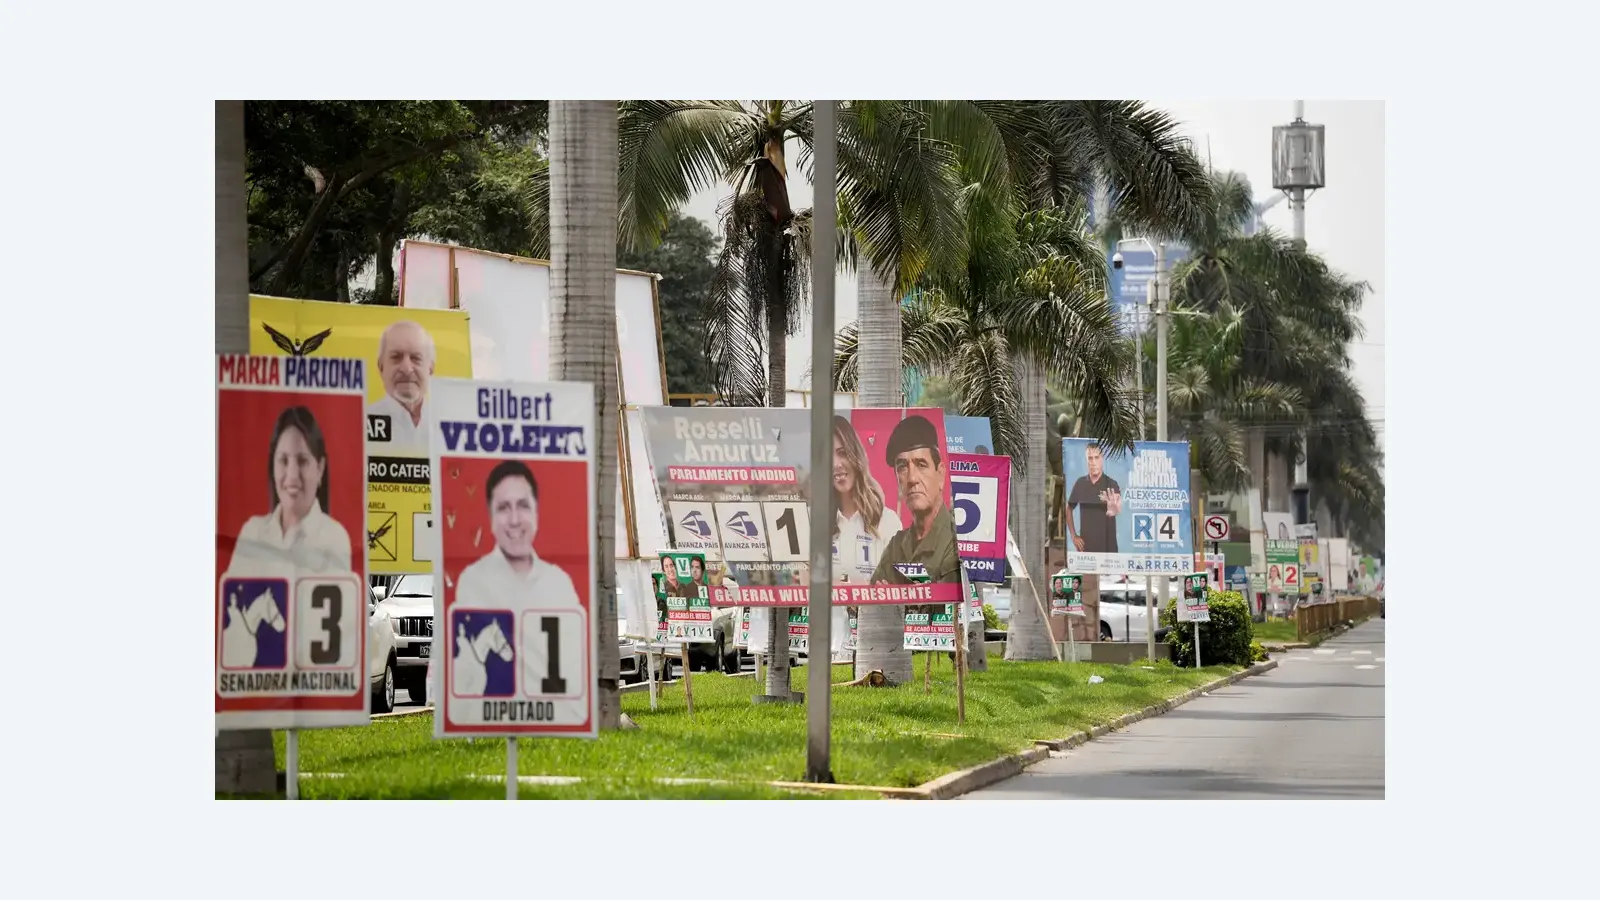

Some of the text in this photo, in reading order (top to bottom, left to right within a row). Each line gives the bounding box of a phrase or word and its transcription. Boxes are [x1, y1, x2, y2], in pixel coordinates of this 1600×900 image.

[218, 355, 363, 390] MARIA PARIONA
[477, 387, 553, 421] Gilbert
[673, 416, 764, 440] Rosselli
[684, 440, 780, 463] Amuruz
[950, 460, 980, 472] LIMA
[669, 468, 795, 482] PARLAMENTO ANDINO
[1125, 490, 1187, 501] ALEX SEGURA
[952, 481, 981, 535] 5
[776, 508, 800, 555] 1
[1134, 515, 1153, 540] R
[1159, 516, 1175, 540] 4
[678, 541, 703, 549] AVANZA
[725, 540, 766, 549] AVANZA PAÍS
[958, 542, 980, 552] RIBE
[862, 546, 869, 562] 1
[678, 560, 687, 572] V
[736, 563, 781, 571] PARLAMENTO
[963, 560, 995, 570] AZON
[1128, 560, 1135, 569] R
[1146, 560, 1152, 569] R
[1155, 560, 1161, 569] R
[1164, 560, 1170, 569] R
[1172, 560, 1178, 570] 4
[1182, 560, 1189, 570] R
[1285, 566, 1297, 583] 2
[700, 588, 705, 598] 1
[851, 587, 932, 602] PRESIDENTE
[668, 598, 706, 607] ALEX LAY
[947, 605, 953, 614] 1
[310, 584, 343, 665] 3
[936, 614, 952, 622] LAY
[684, 627, 690, 635] V
[692, 627, 696, 637] 1
[707, 627, 712, 637] 1
[802, 640, 807, 648] 1
[932, 638, 937, 647] 1
[950, 638, 955, 647] 1
[541, 616, 567, 694] 1
[219, 672, 356, 692] SENADORA NACIONAL
[483, 701, 554, 722] DIPUTADO
